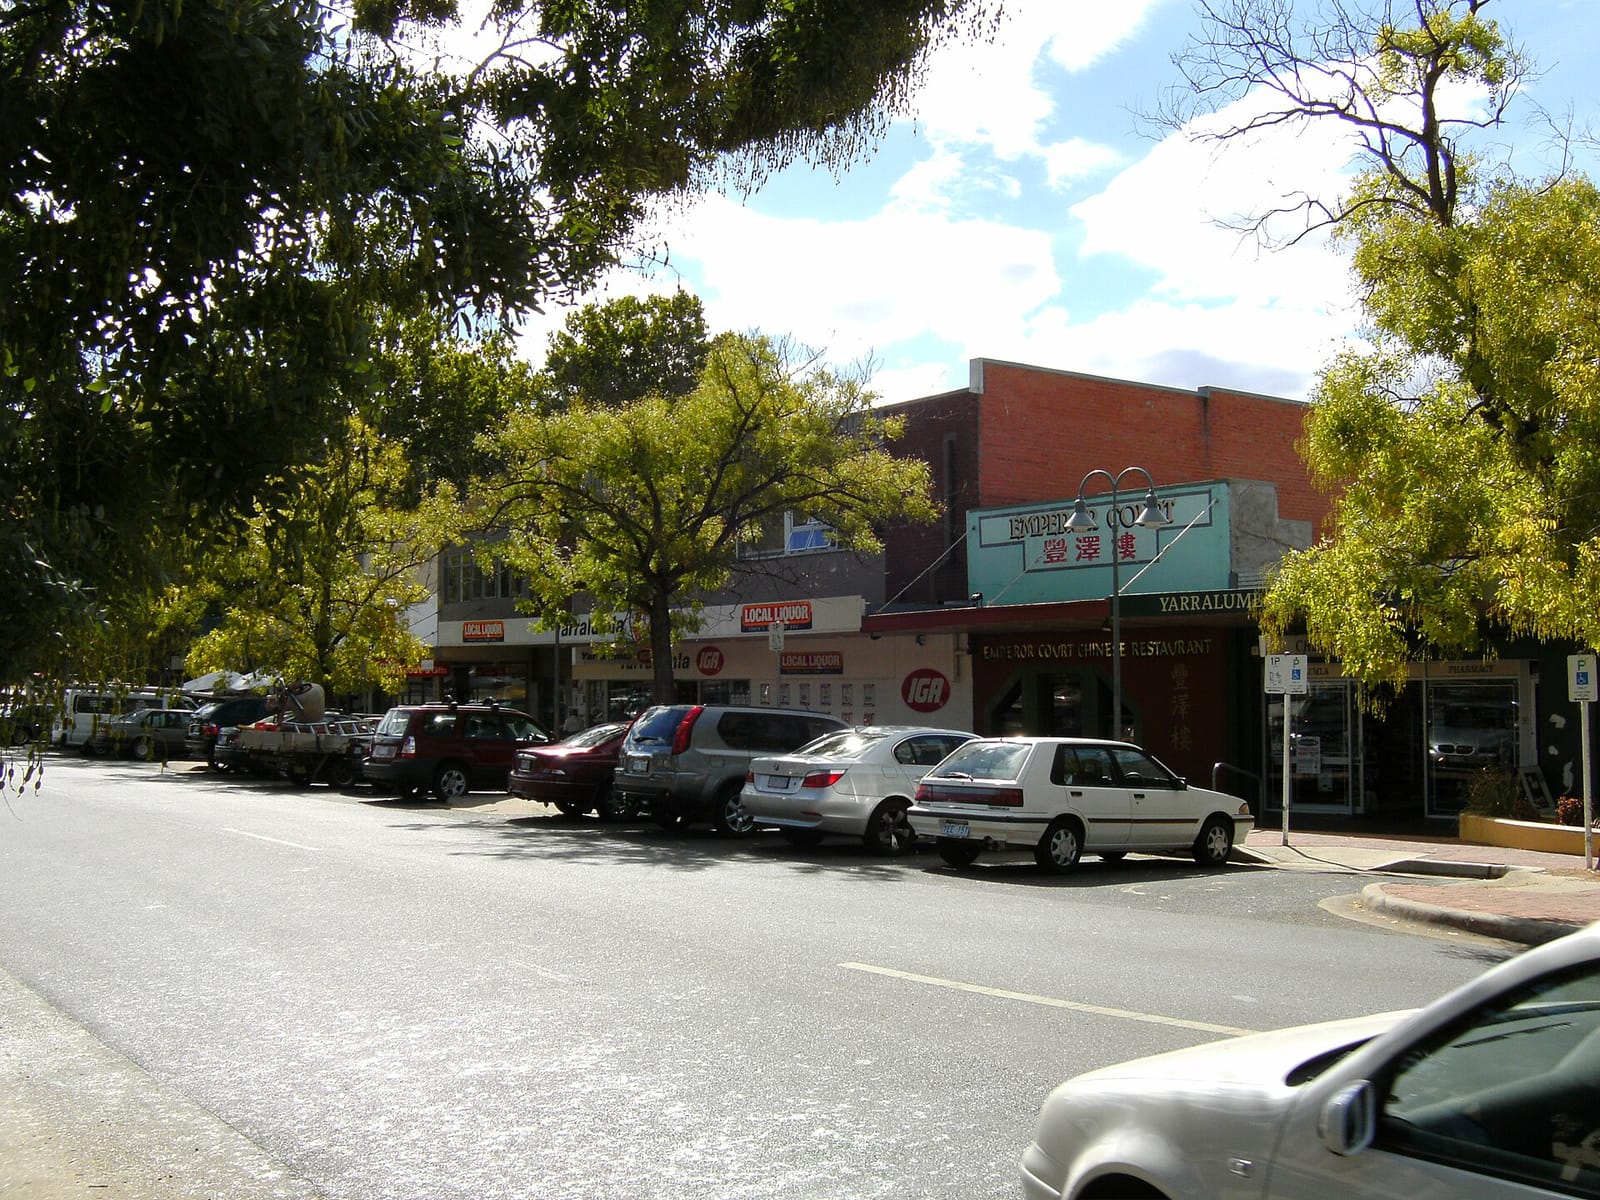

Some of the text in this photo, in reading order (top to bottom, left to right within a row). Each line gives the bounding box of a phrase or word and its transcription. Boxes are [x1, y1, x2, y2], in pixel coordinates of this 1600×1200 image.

[744, 606, 774, 623] LOCAL
[464, 623, 481, 635] LOCAL
[1038, 644, 1073, 658] COURT
[1131, 639, 1211, 656] RESTAURANT
[699, 652, 720, 671] IGA
[782, 655, 808, 666] LOCAL
[1270, 656, 1281, 666] 1P
[1577, 660, 1585, 671] P
[907, 677, 945, 704] IGA
